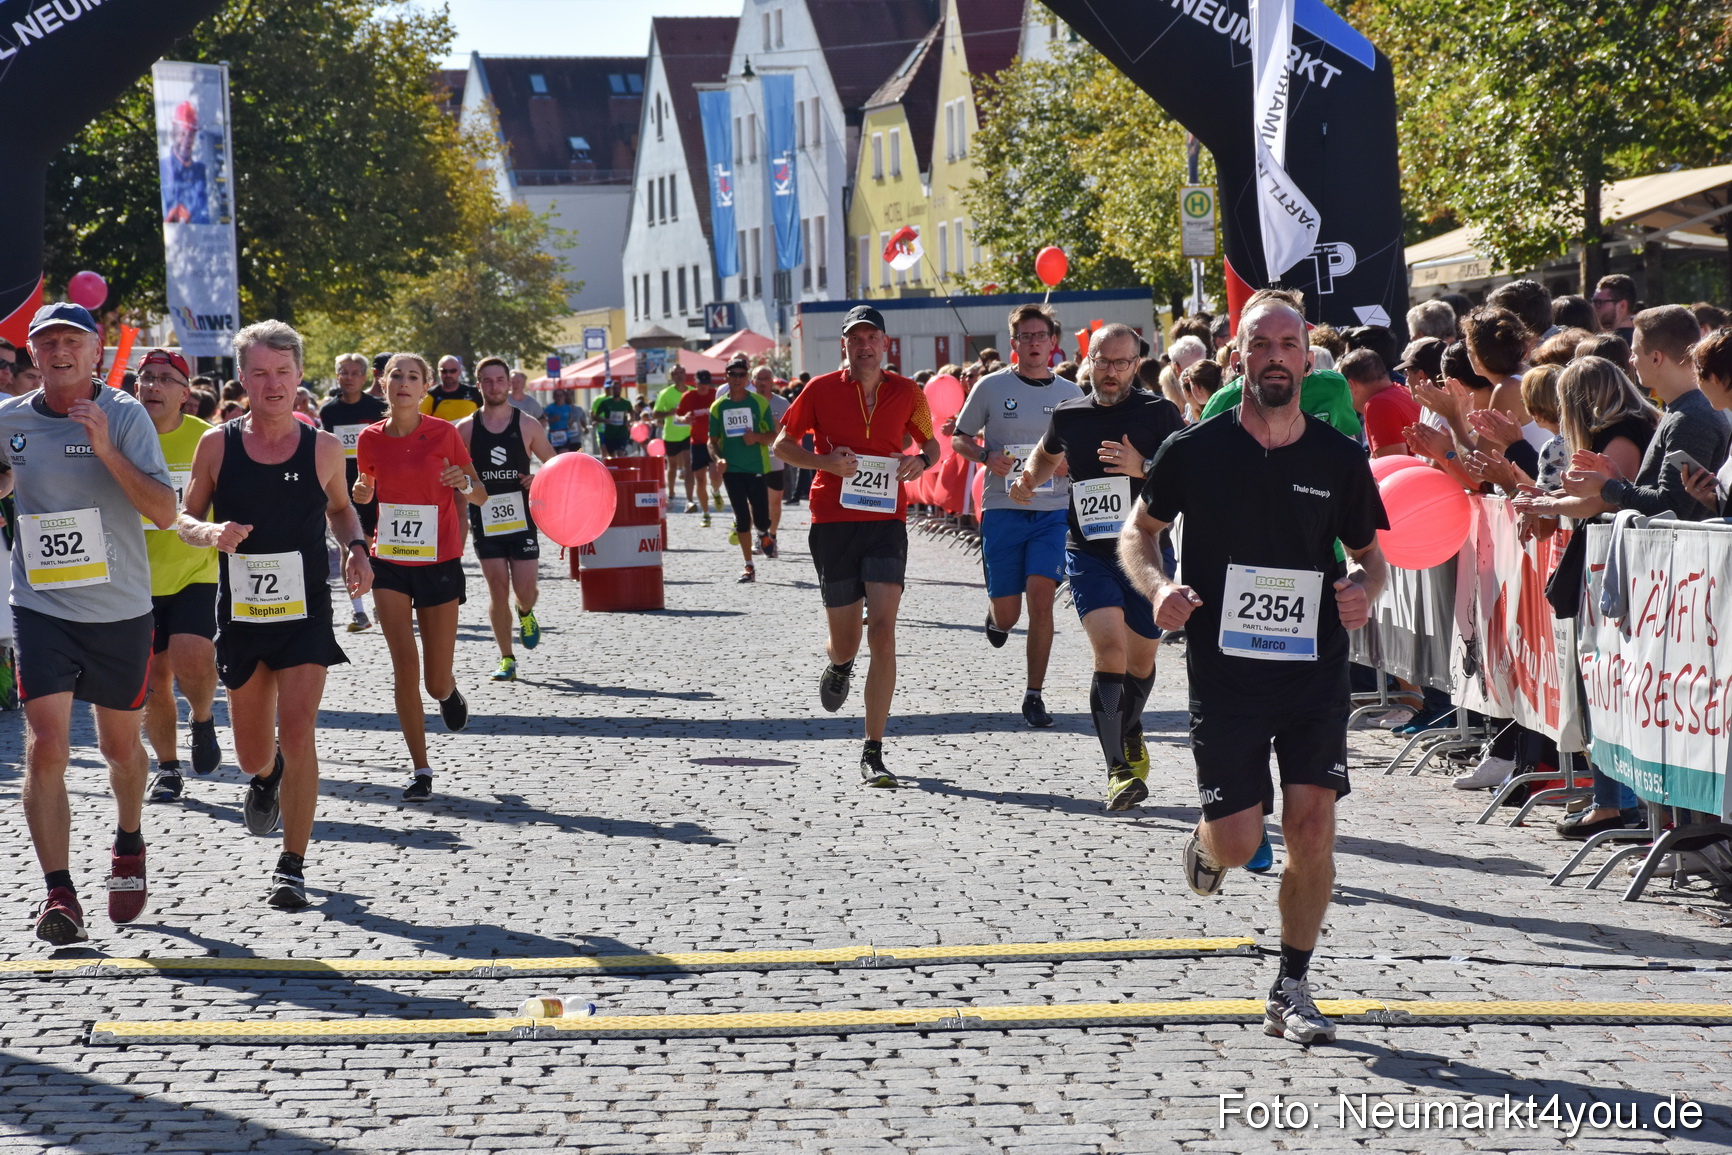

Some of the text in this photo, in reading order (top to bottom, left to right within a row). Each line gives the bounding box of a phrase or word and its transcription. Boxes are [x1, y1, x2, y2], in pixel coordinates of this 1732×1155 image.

[1171, 0, 1342, 88] NEUMRKT
[727, 415, 748, 425] 3018
[482, 470, 518, 480] SINGER
[851, 470, 889, 490] 2241
[1293, 484, 1328, 498] Thule Group
[858, 497, 881, 507] Jürgen
[1080, 494, 1121, 516] 2240
[491, 504, 515, 519] 336
[391, 520, 423, 537] 147
[1088, 524, 1113, 533] Helmut
[40, 531, 85, 558] 352
[392, 546, 419, 556] Simone
[250, 573, 279, 594] 72
[1255, 576, 1296, 588] BOCK
[249, 606, 286, 617] Stephan
[1237, 592, 1305, 623] 2354
[1242, 623, 1290, 633] PARTL Neumarkt
[1251, 636, 1286, 650] Marco
